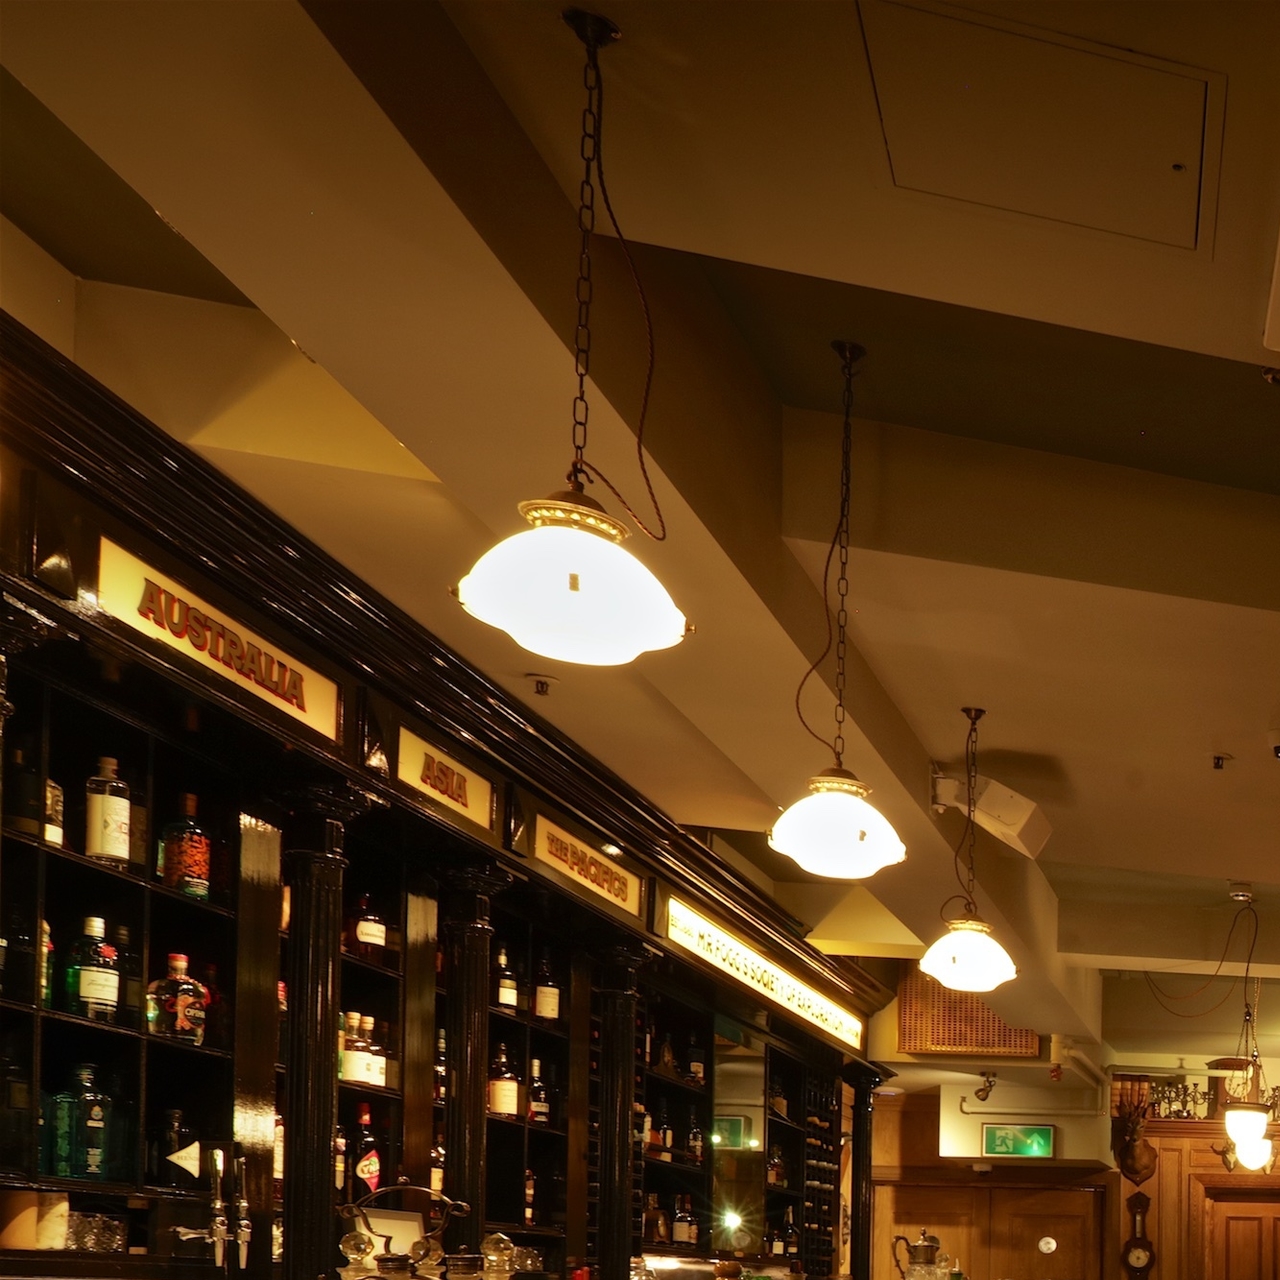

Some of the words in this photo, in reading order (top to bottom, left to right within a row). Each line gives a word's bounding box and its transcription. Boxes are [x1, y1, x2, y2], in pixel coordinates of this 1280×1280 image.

[137, 576, 307, 714] AUSTRALIA
[420, 751, 469, 809] ASIA
[546, 830, 570, 865] THE
[568, 842, 629, 903] PACIFICS
[696, 930, 713, 954] MR
[714, 939, 749, 977] FOGGS
[750, 961, 784, 998] SOCIETY
[786, 984, 796, 1004] OF
